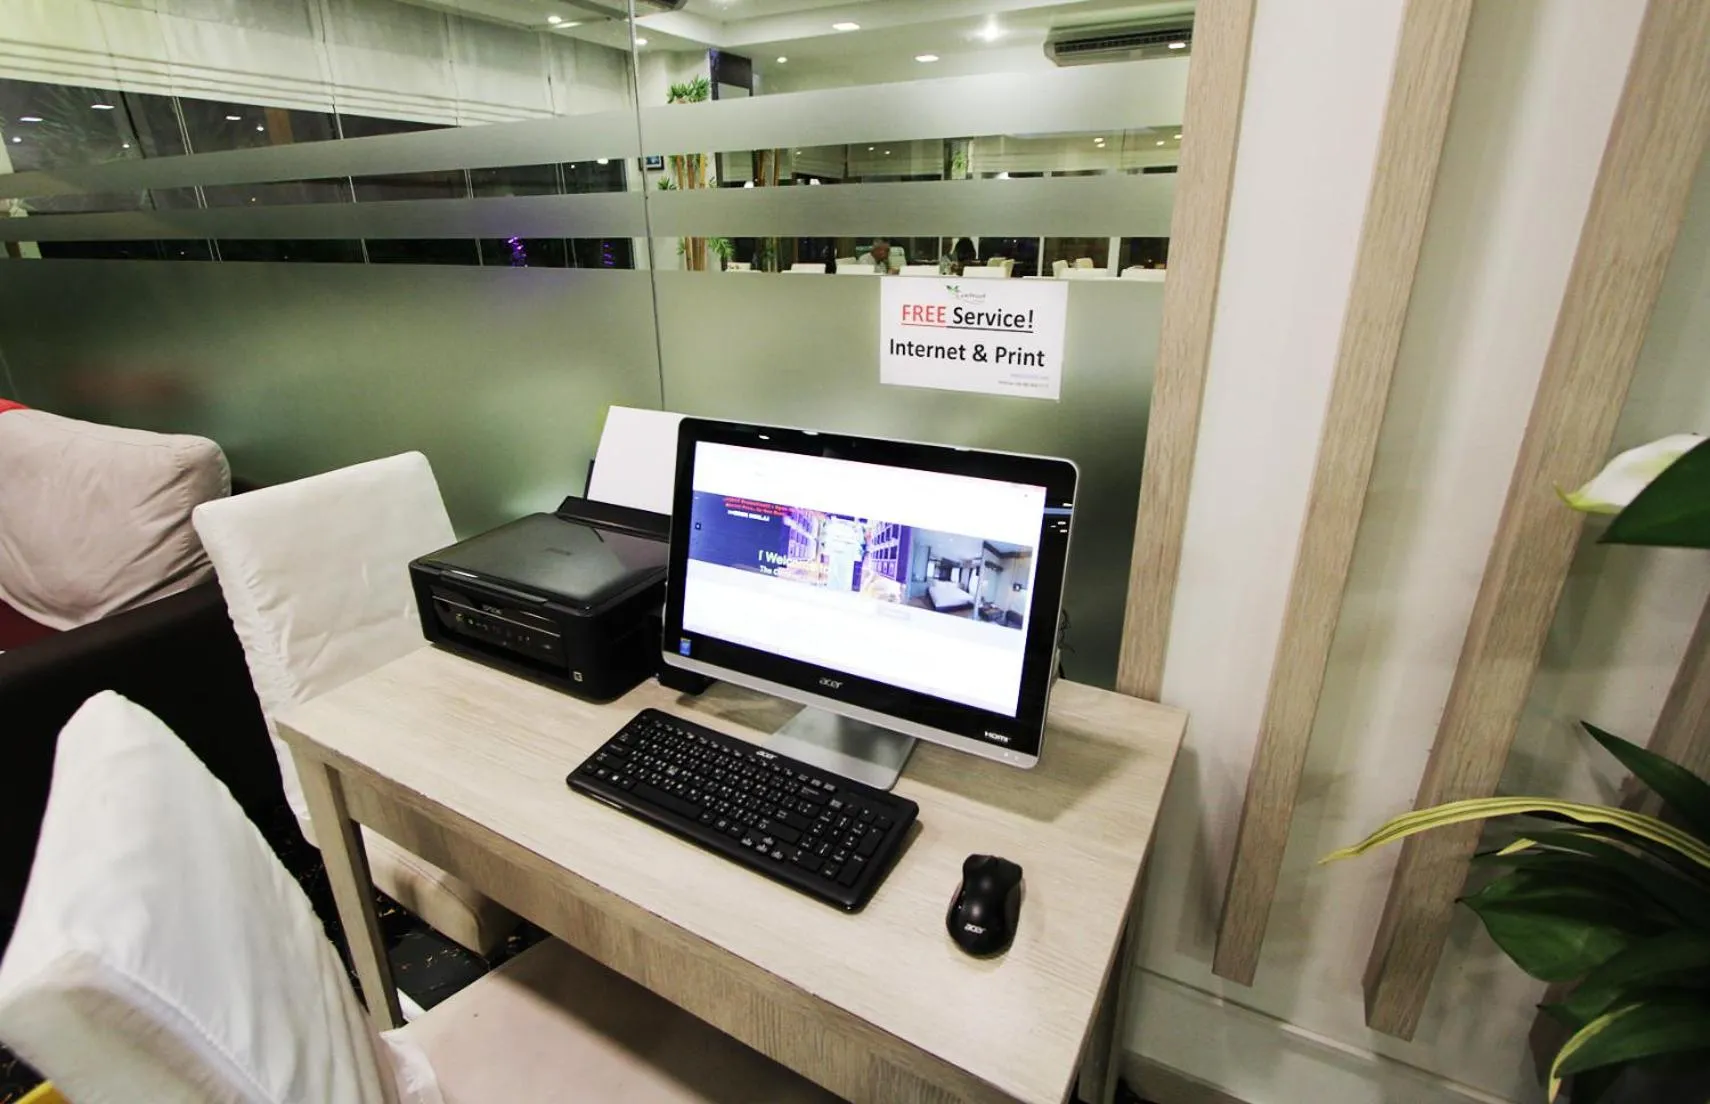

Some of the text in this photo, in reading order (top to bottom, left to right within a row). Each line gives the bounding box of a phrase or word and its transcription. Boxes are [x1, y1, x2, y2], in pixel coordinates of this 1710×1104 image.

[902, 304, 1034, 329] FREE Service!
[890, 338, 1045, 367] Internet & Print
[818, 676, 843, 689] acer
